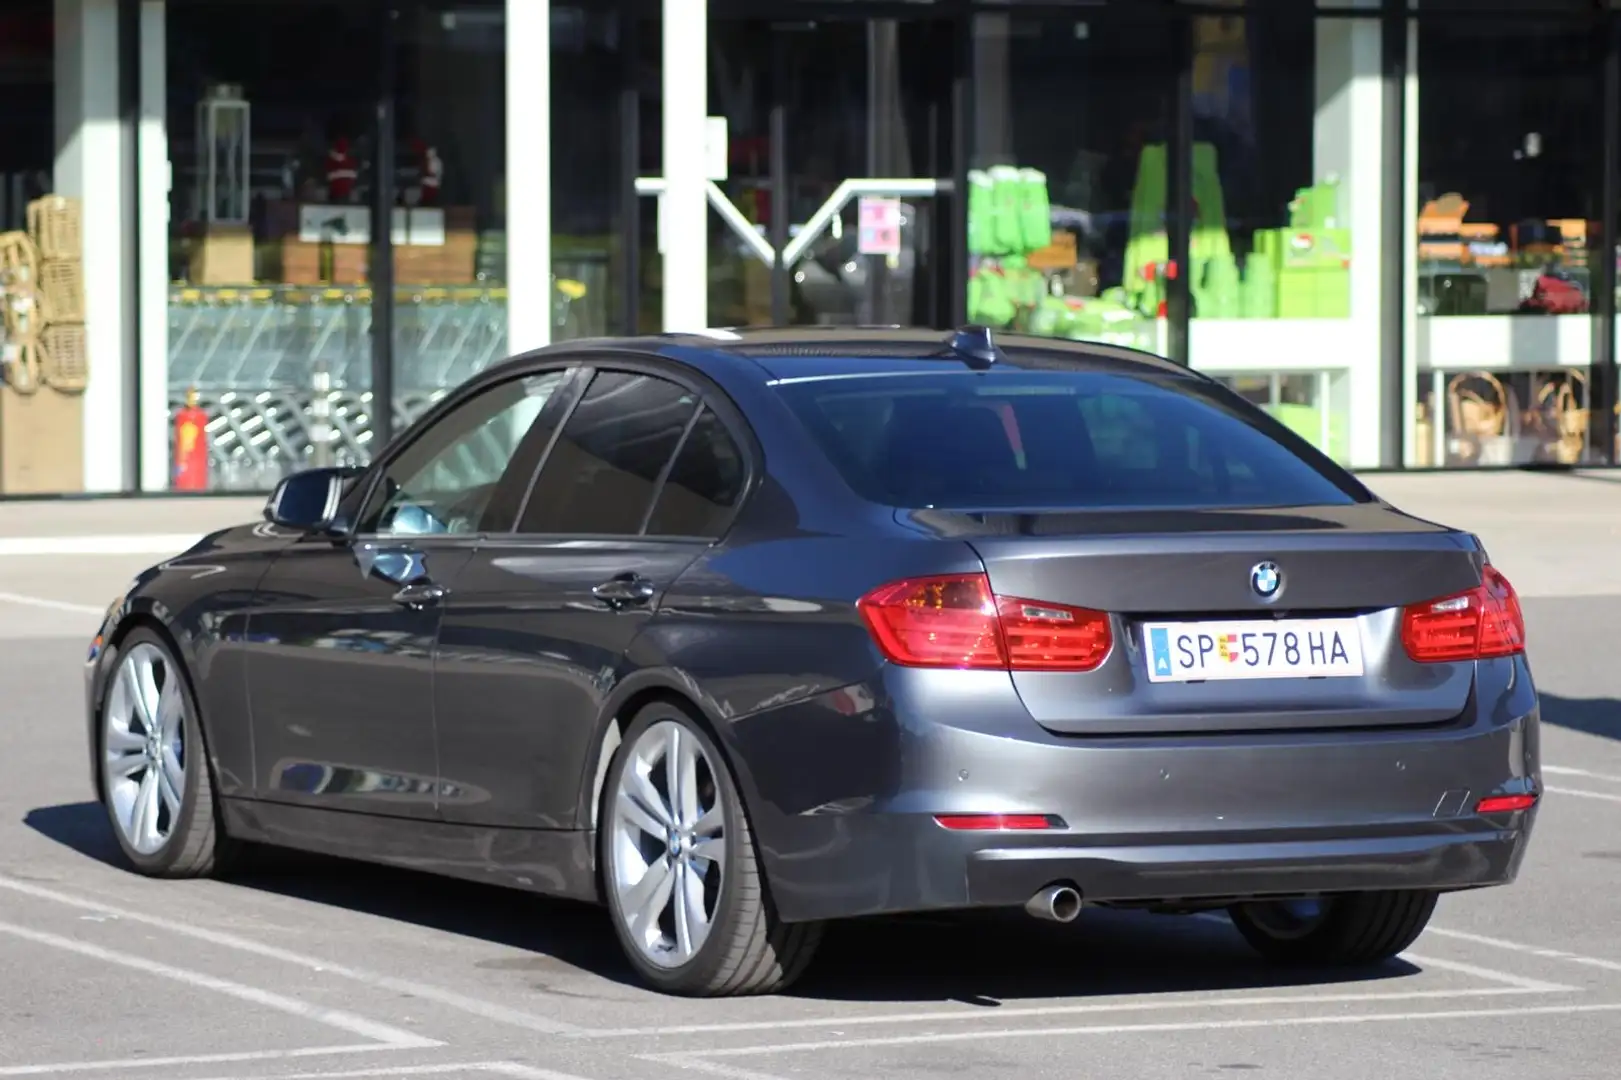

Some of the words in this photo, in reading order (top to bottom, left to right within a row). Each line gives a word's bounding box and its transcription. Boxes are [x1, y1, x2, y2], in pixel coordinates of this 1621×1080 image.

[1177, 634, 1214, 668] SP
[1242, 632, 1301, 666] 578
[1308, 631, 1349, 665] HA
